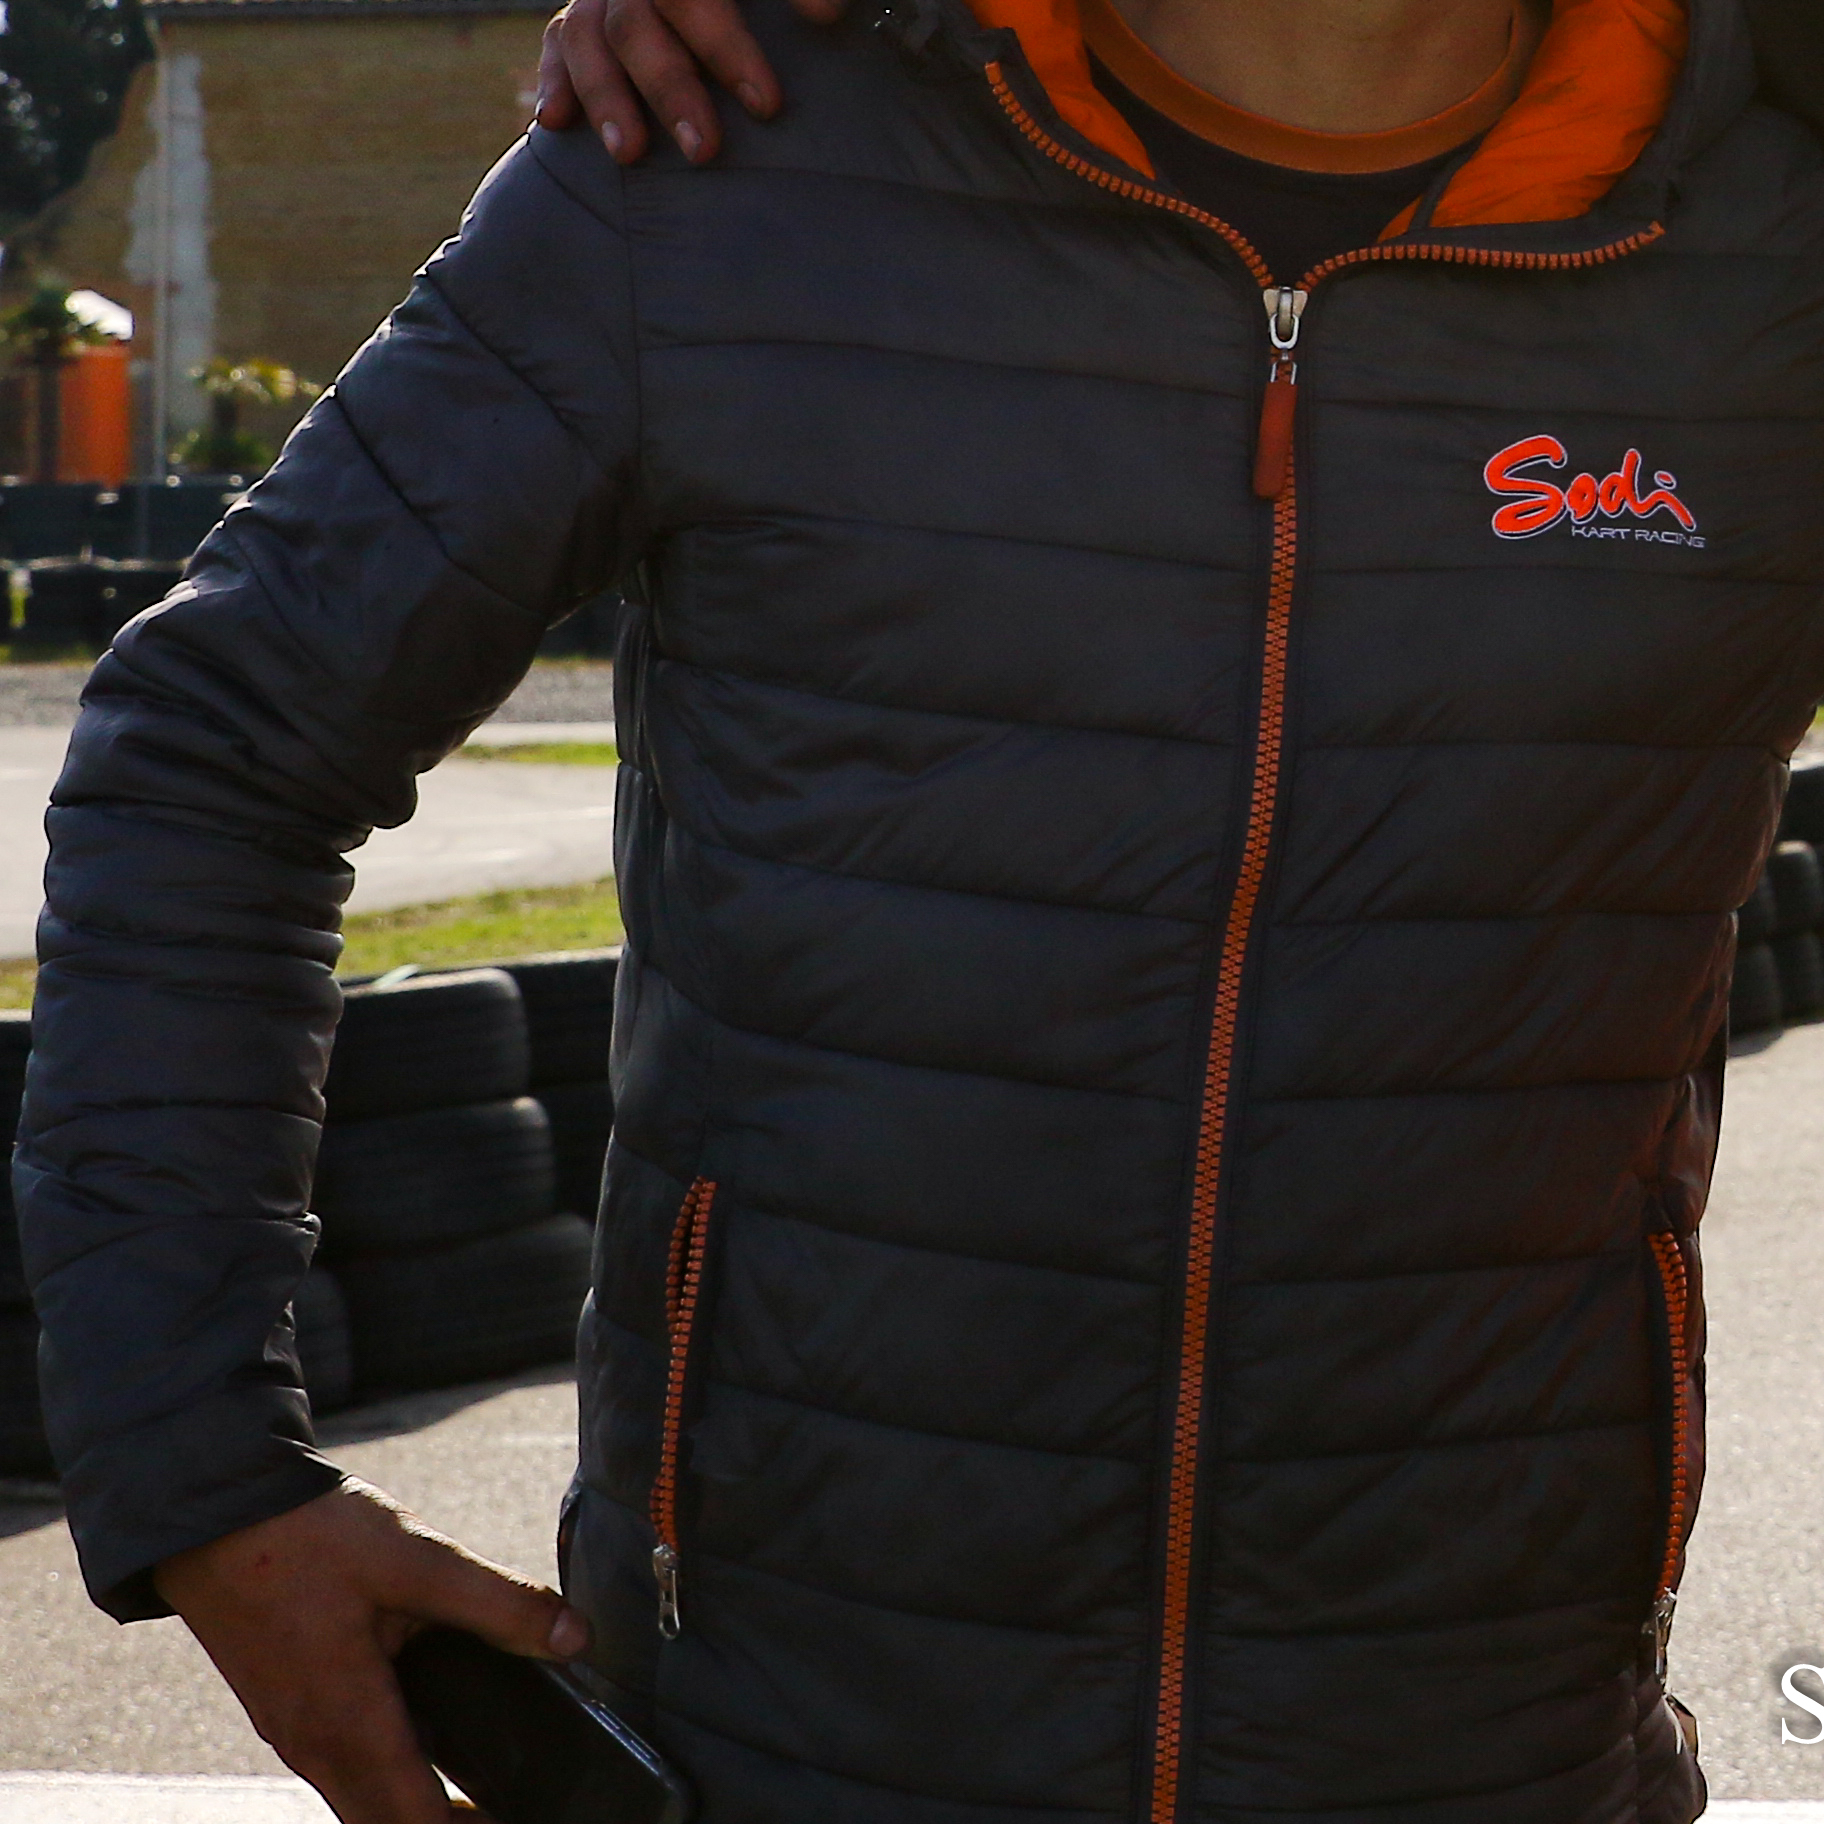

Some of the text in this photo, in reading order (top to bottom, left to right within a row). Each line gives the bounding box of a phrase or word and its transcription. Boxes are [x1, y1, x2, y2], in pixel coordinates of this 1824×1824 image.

[1484, 434, 1696, 540] Sodi
[1571, 526, 1706, 549] KART RACING
